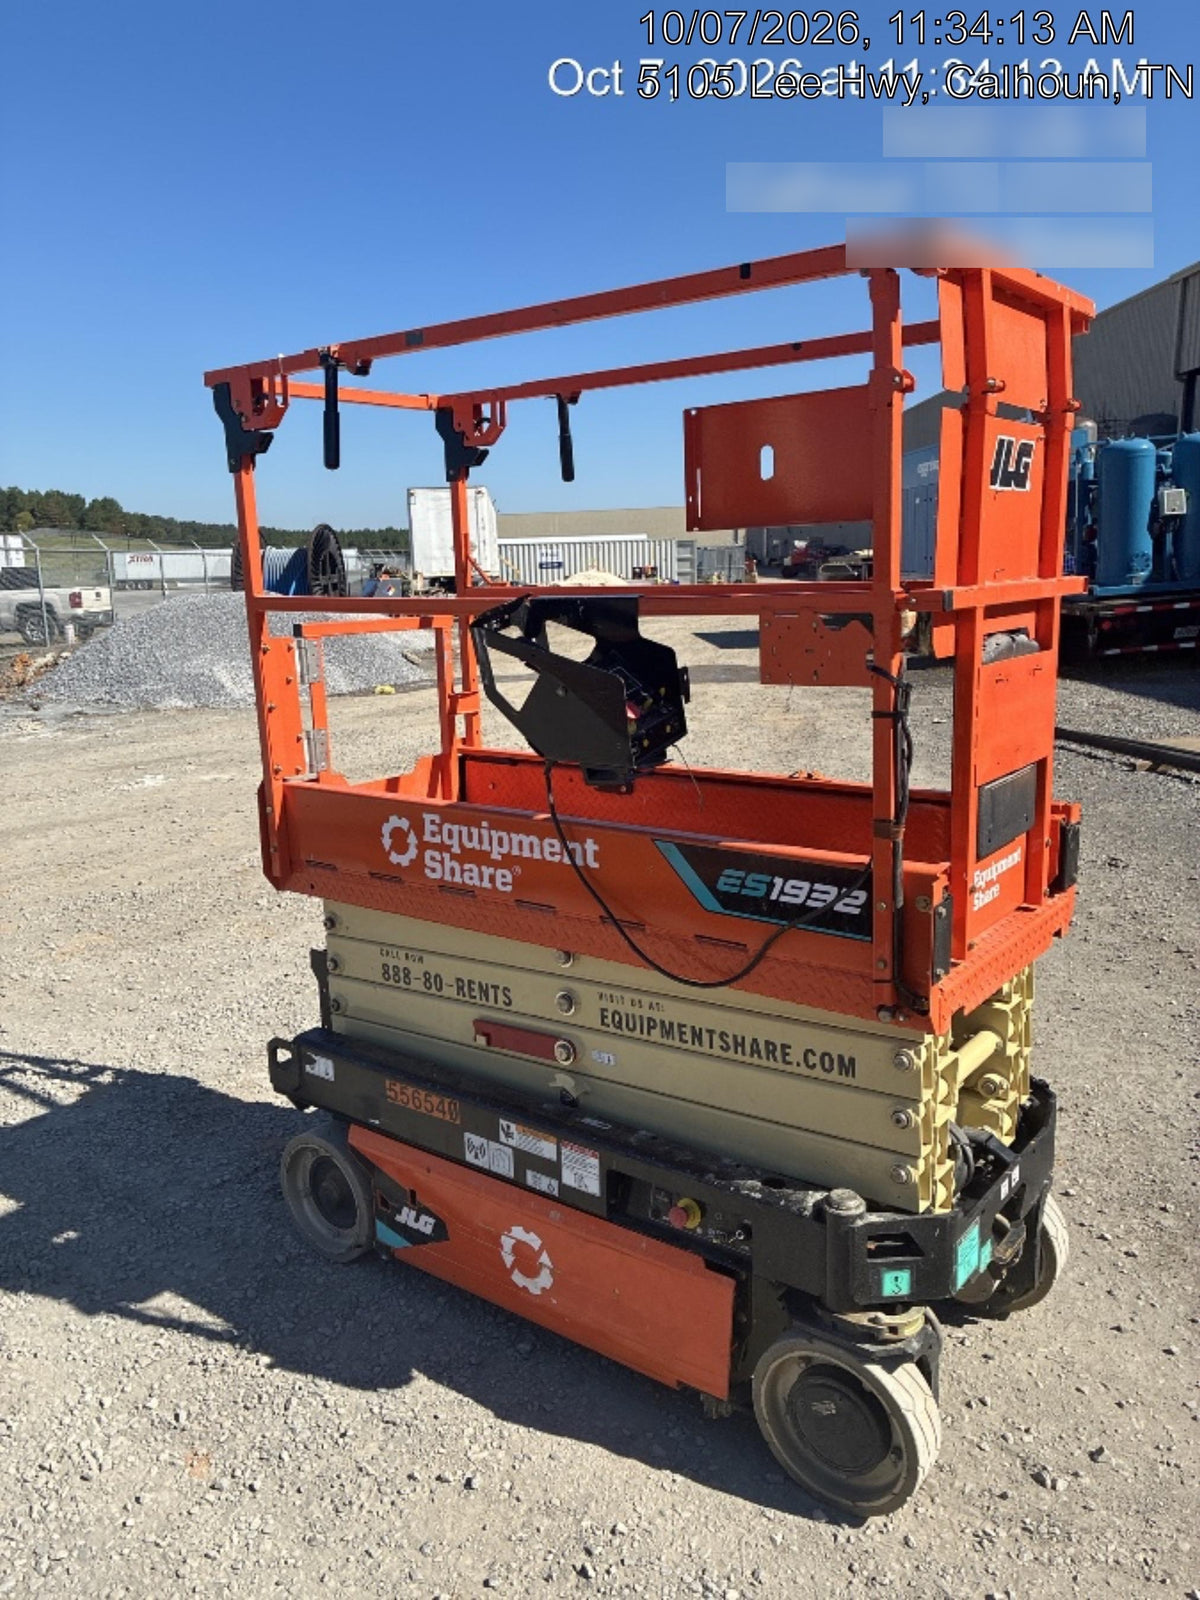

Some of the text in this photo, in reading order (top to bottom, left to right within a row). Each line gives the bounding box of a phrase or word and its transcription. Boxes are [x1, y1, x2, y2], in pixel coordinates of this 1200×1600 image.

[989, 435, 1035, 491] JLG
[422, 812, 600, 869] Equipment
[974, 846, 1022, 890] Equipment
[716, 868, 868, 915] ES1932
[973, 883, 1000, 912] Share
[381, 962, 513, 1007] 888-80-RENTS
[599, 1007, 858, 1079] EQUIPMENTSHARE.COM
[394, 1206, 436, 1236] JLG
